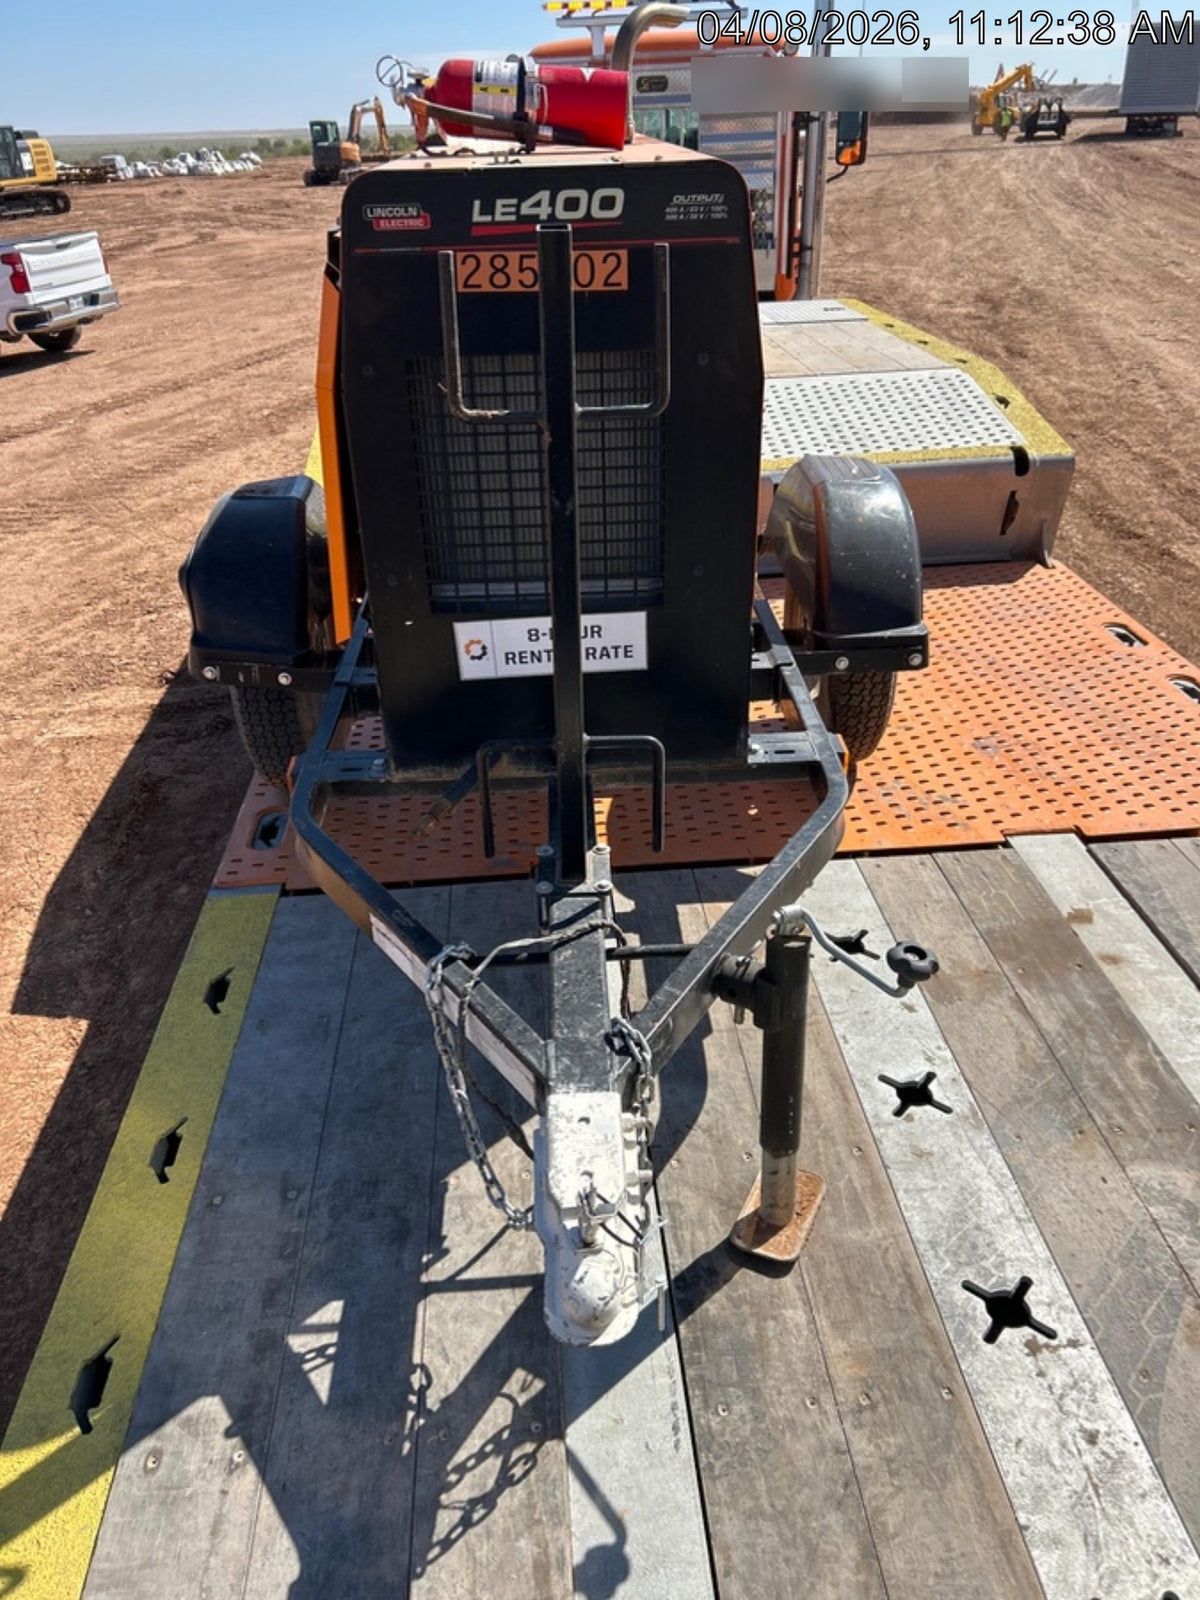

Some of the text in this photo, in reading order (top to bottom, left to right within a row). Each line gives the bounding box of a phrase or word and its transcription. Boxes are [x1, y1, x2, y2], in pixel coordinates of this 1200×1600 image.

[367, 206, 418, 218] LINCOLN
[472, 188, 625, 222] LE400
[379, 218, 425, 227] ELECTRIC
[459, 253, 623, 289] 28502
[527, 625, 602, 642] 8-UR
[504, 645, 634, 666] RENT RATE
